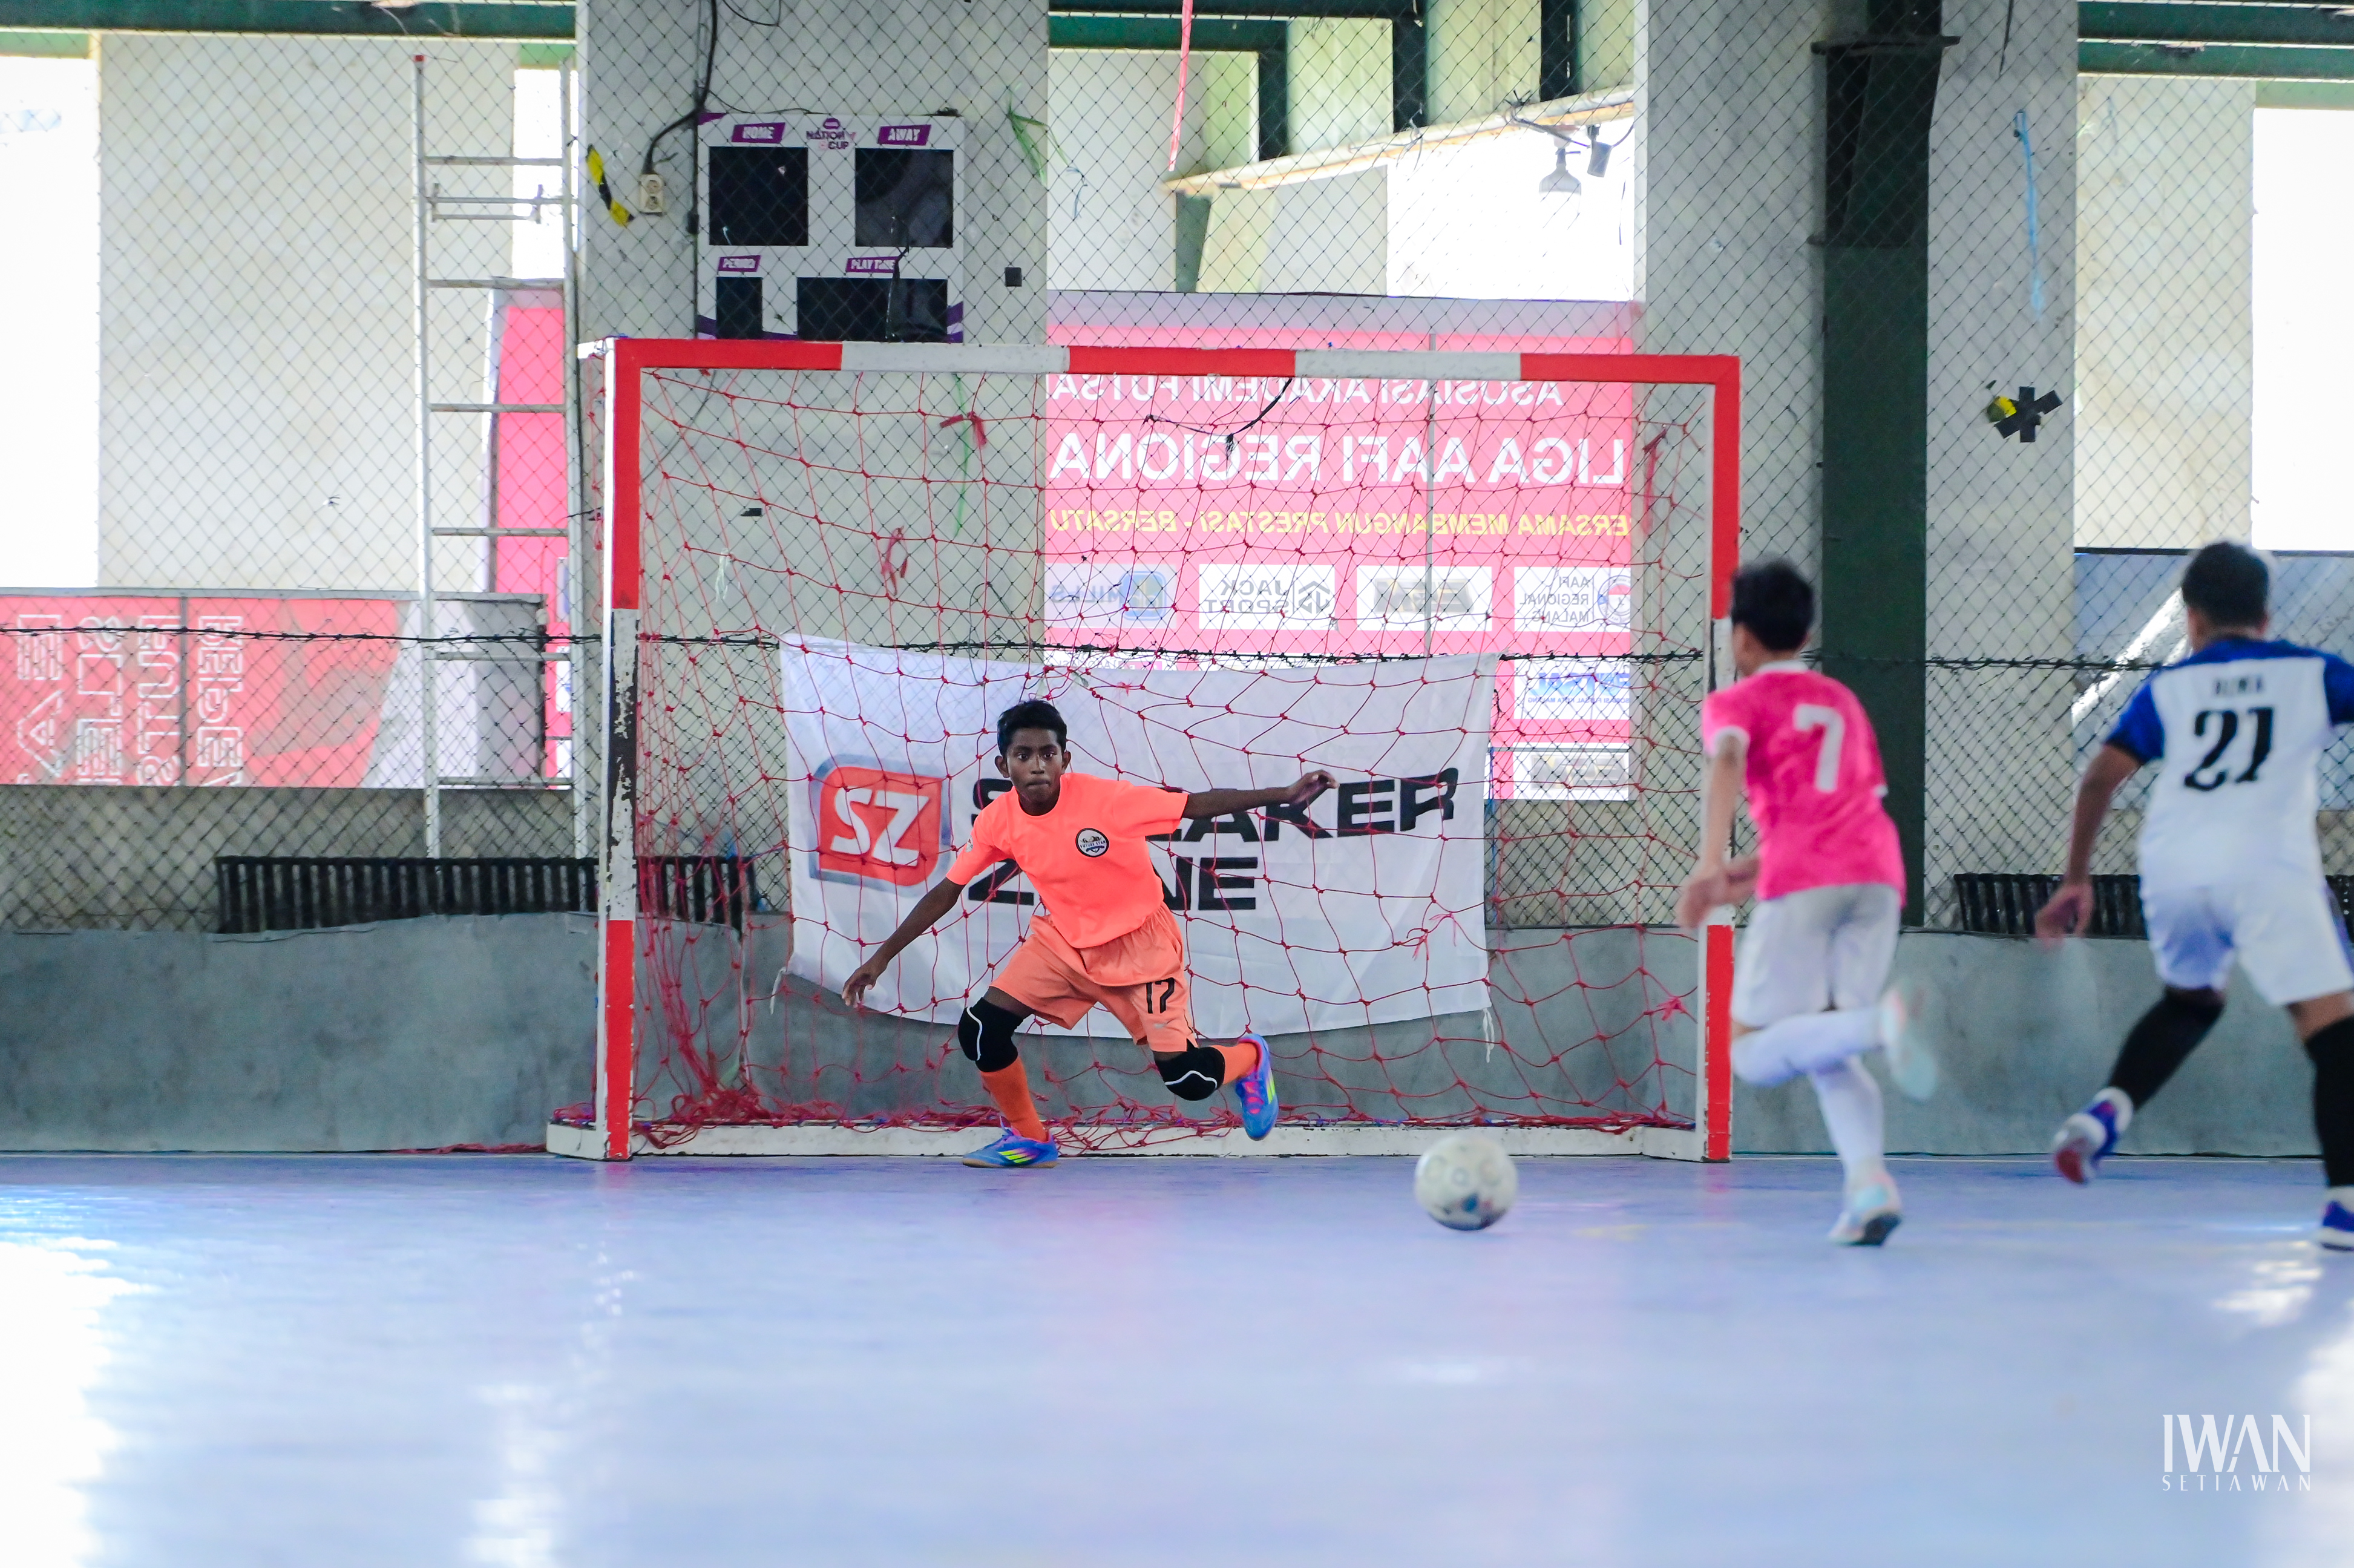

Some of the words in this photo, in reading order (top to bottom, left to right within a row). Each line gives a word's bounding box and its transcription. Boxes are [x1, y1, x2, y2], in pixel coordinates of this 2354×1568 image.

[743, 126, 775, 139] HOME
[888, 128, 920, 141] AWAY
[1794, 704, 1844, 792] 7
[2183, 706, 2274, 792] 21
[830, 784, 933, 867] SZ
[1146, 977, 1175, 1014] 17
